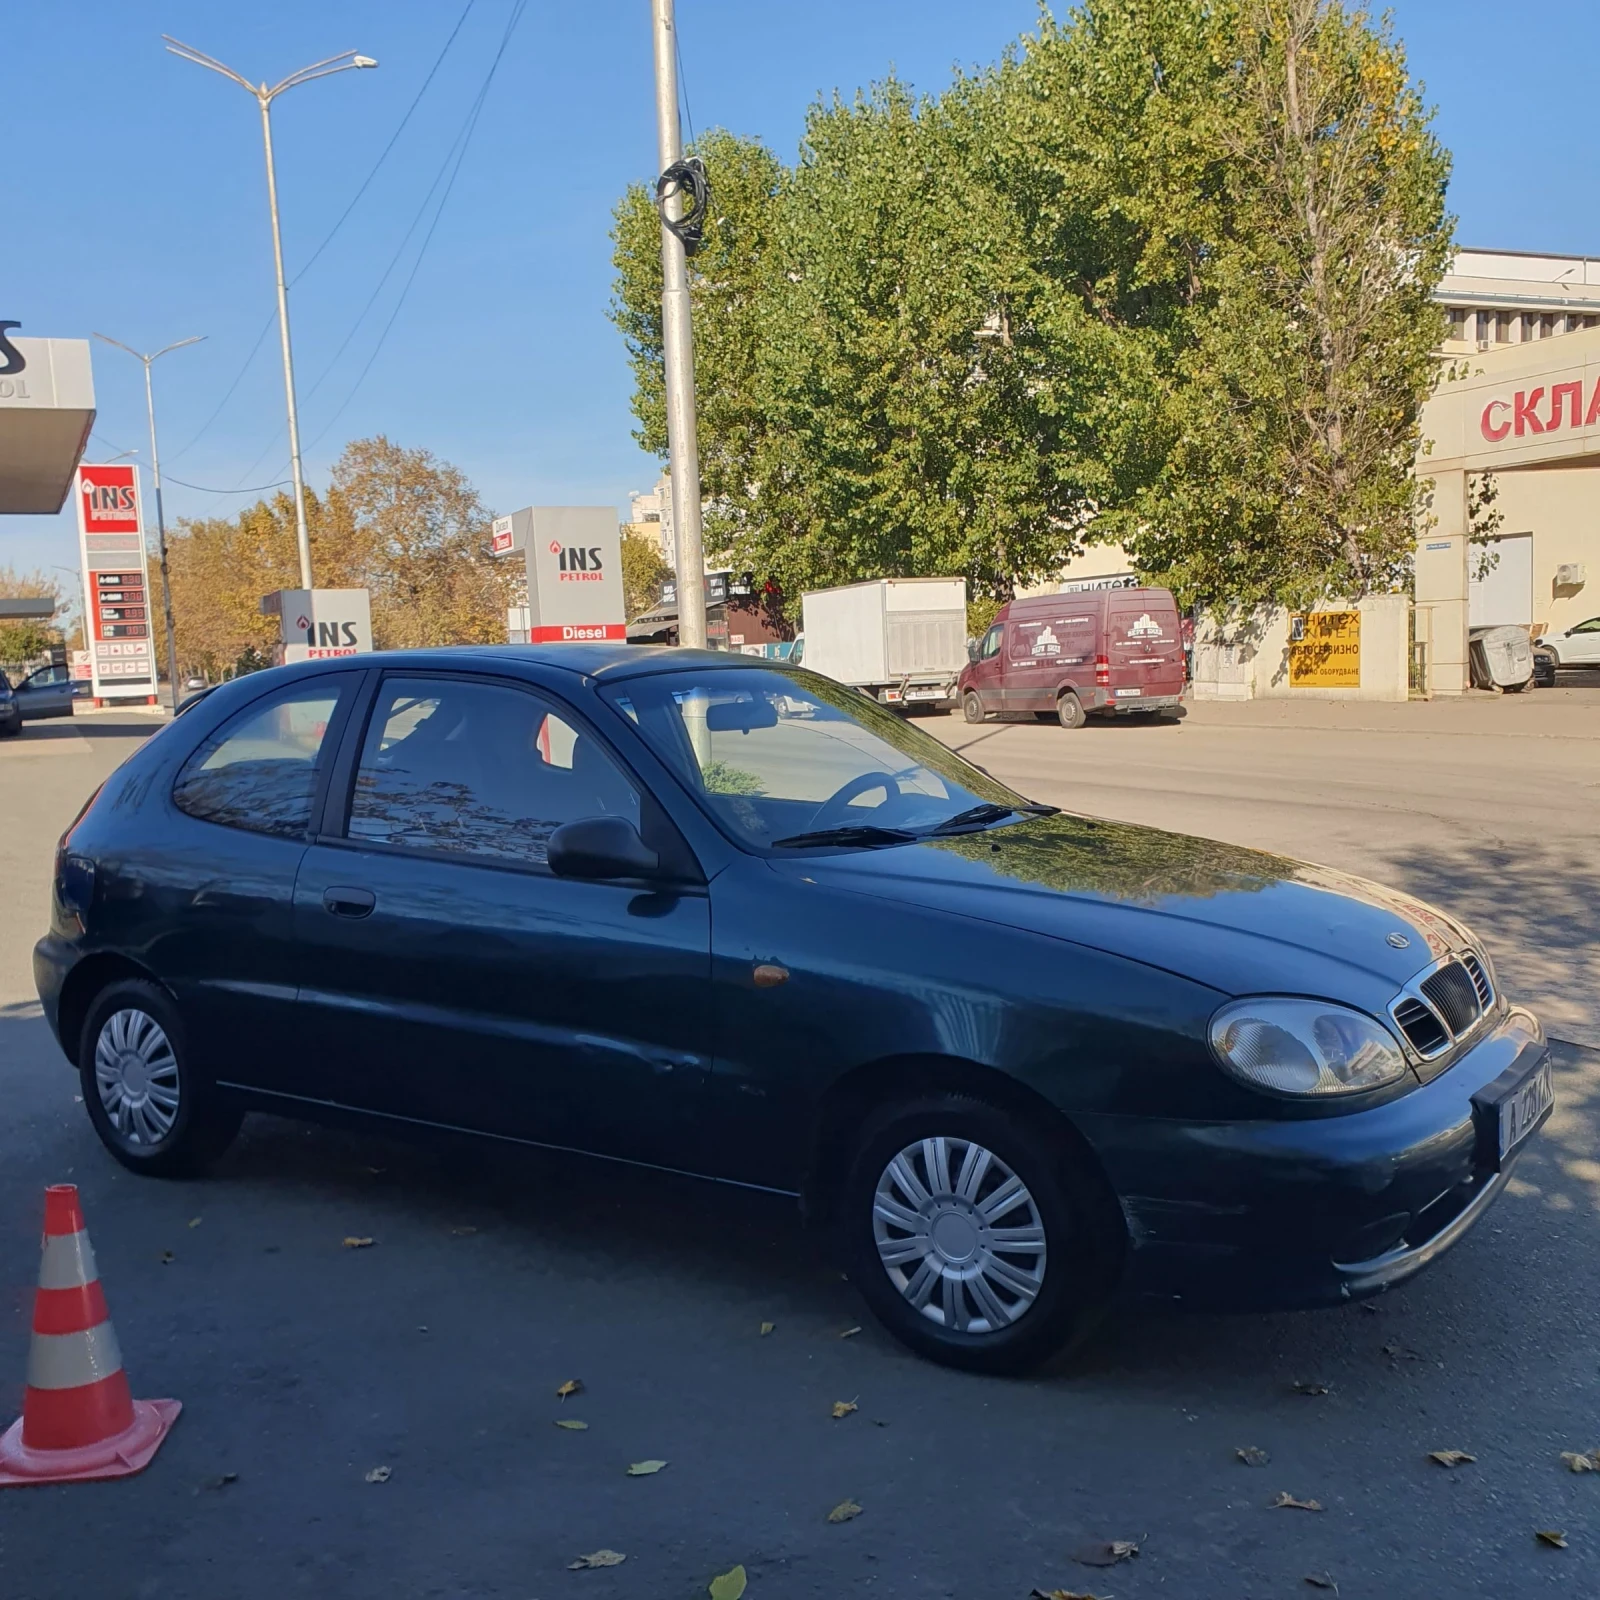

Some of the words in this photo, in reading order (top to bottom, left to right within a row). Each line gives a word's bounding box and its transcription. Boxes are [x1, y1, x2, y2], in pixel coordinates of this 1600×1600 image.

[90, 485, 135, 511] INS
[559, 547, 603, 571] INS
[560, 572, 604, 581] PETROL
[307, 621, 358, 648] INS
[563, 626, 607, 640] Diesel
[1291, 644, 1359, 655] АВТОСЕРВИЗНО
[1319, 667, 1359, 677] ОБОРУДВАНЕ
